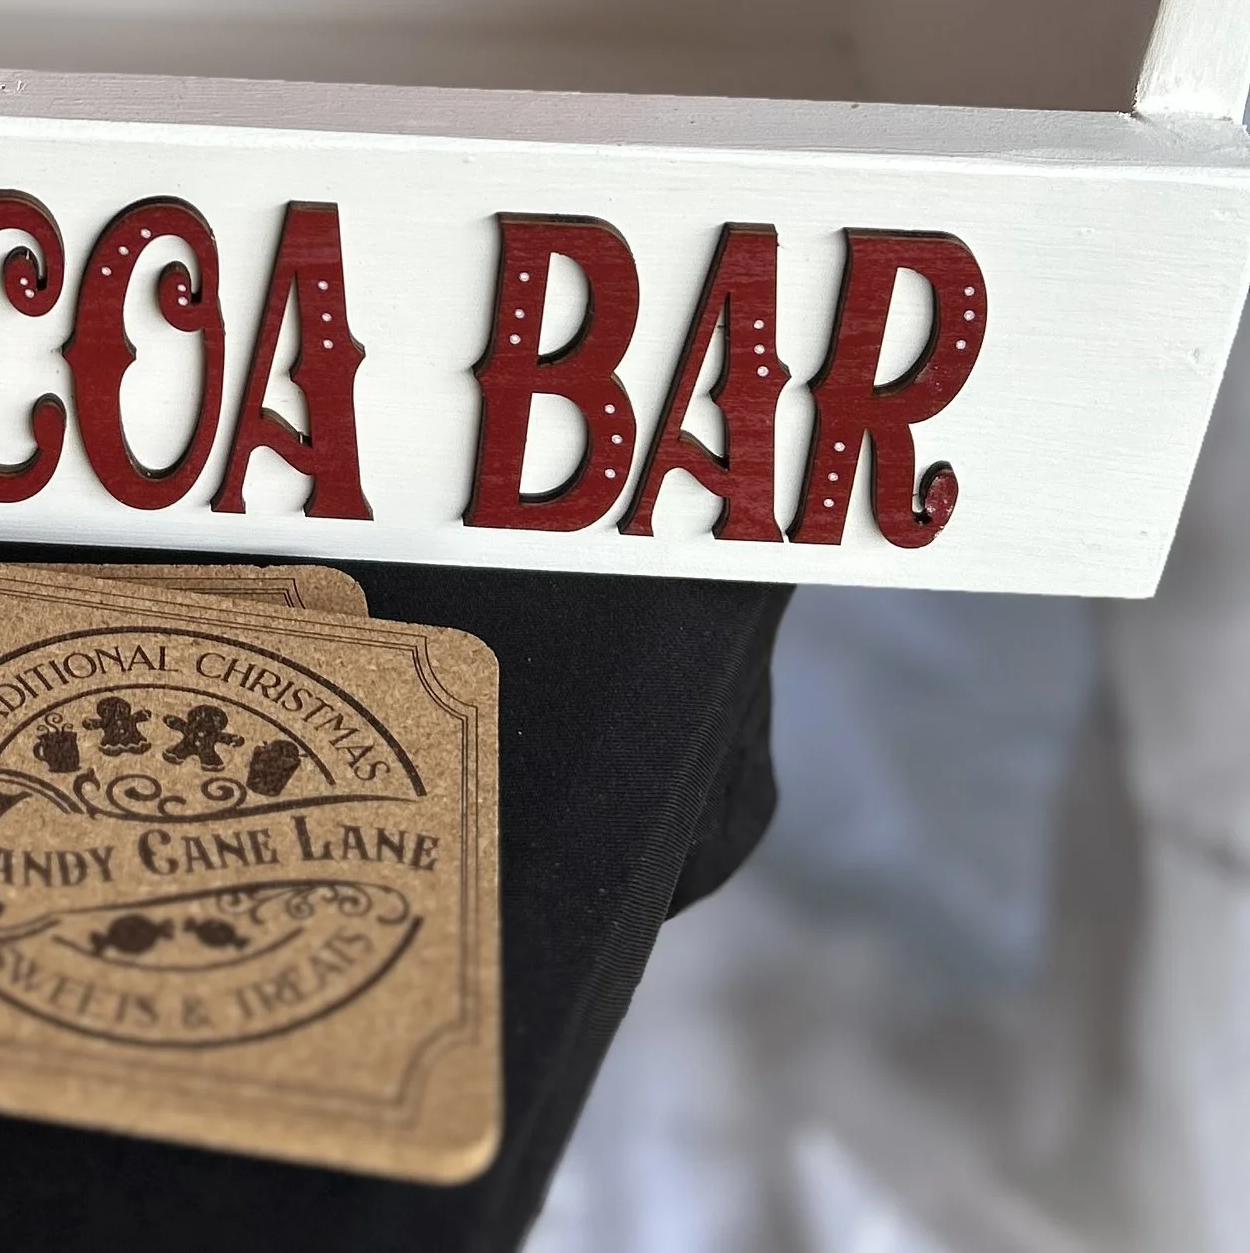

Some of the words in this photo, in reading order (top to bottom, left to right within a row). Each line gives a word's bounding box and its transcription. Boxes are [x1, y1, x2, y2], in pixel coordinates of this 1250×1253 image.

[463, 211, 988, 548] BAR
[195, 651, 392, 783] CHRISTMAS
[182, 990, 213, 1029] &
[234, 927, 376, 1022] TREATS
